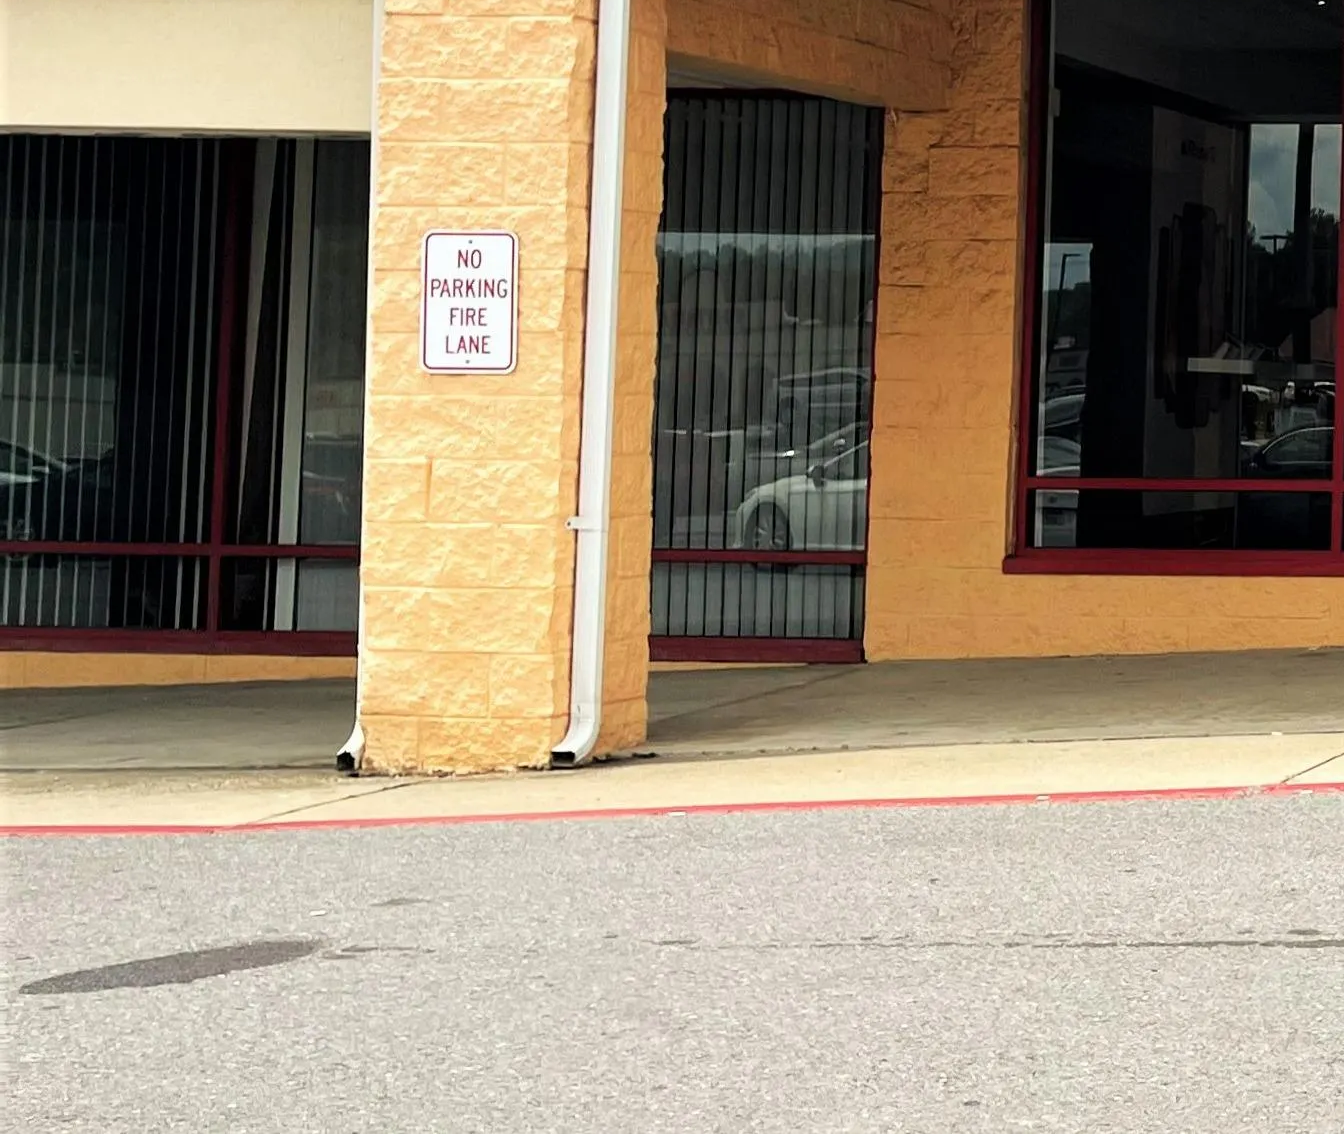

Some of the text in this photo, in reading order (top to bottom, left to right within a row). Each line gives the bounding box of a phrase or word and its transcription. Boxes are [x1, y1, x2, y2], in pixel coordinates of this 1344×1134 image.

[457, 249, 482, 269] NO
[430, 278, 508, 299] PARKING
[449, 307, 488, 327] FIRE
[445, 335, 491, 354] LANE
